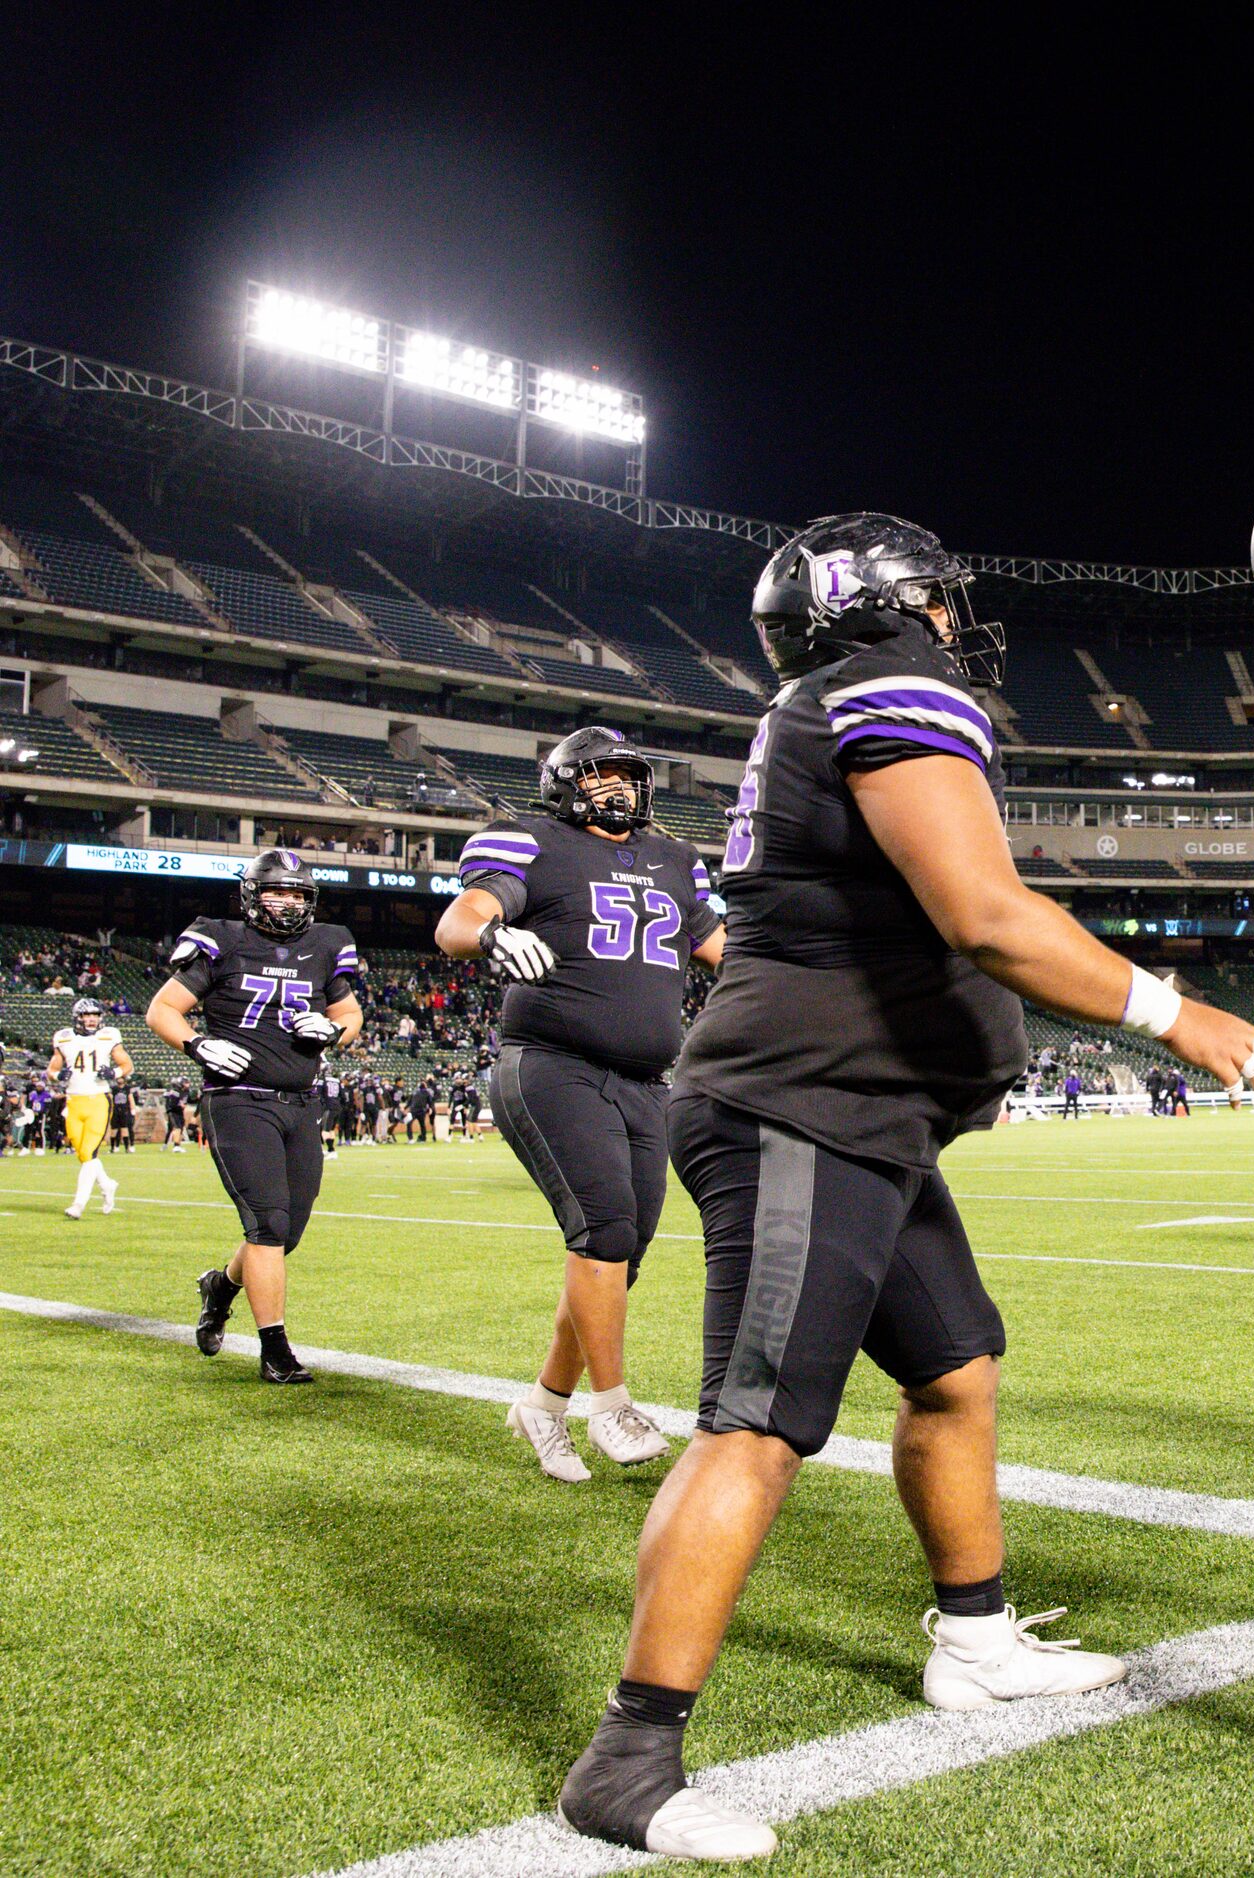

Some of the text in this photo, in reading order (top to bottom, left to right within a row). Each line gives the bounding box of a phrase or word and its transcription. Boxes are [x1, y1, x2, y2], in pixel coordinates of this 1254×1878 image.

[86, 848, 149, 862] HIGHLAND
[1184, 842, 1247, 855] GLOBE
[114, 859, 148, 871] PARK
[157, 855, 182, 870] 28
[211, 861, 230, 872] TOL
[312, 868, 348, 882] DOWN
[382, 874, 398, 885] TO
[399, 875, 415, 886] GO
[611, 871, 655, 887] KNIGHTS
[587, 881, 682, 970] 52
[262, 966, 299, 979] KNIGHTS
[239, 973, 313, 1034] 75
[74, 1049, 98, 1073] 41
[737, 1207, 808, 1388] KNIGHS
